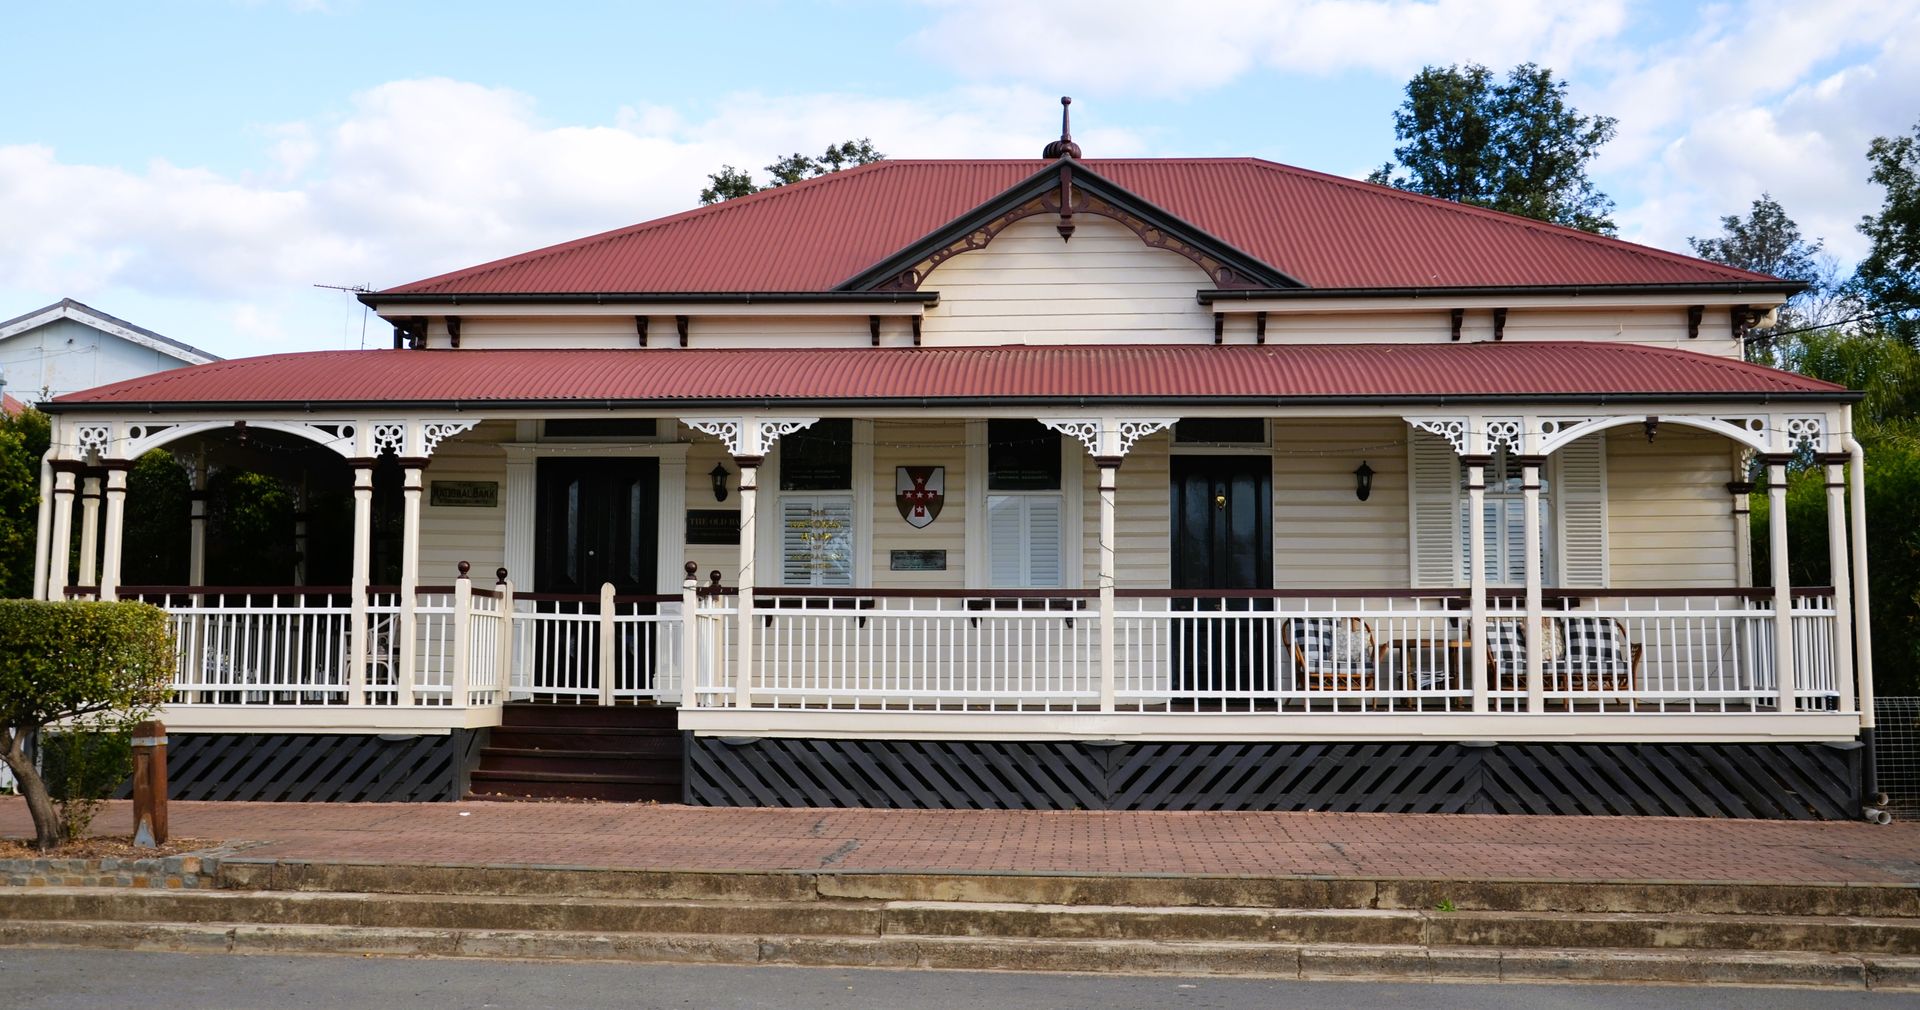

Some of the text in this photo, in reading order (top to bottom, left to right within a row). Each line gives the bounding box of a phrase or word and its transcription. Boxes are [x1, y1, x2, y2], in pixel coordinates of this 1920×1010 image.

[432, 487, 496, 497] NATIONAL BANK
[690, 517, 706, 526] THE
